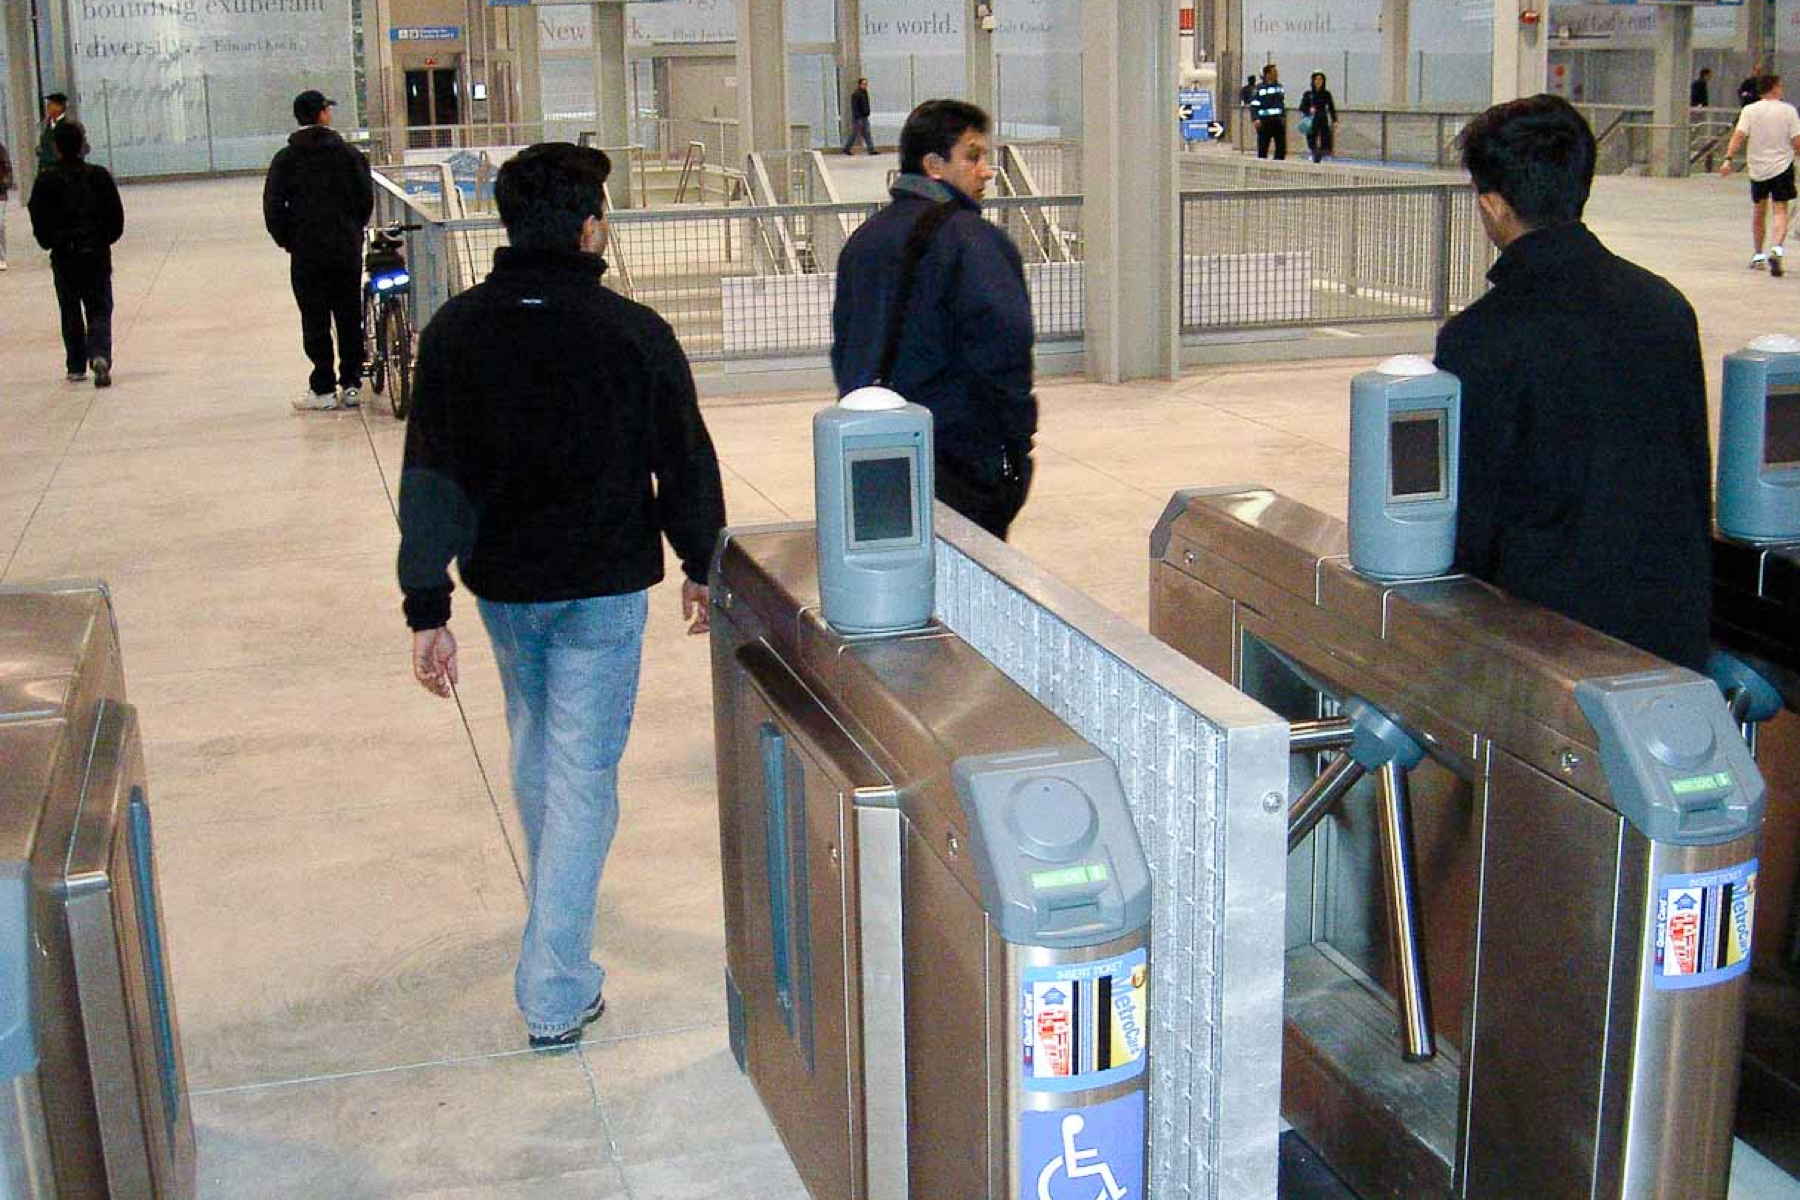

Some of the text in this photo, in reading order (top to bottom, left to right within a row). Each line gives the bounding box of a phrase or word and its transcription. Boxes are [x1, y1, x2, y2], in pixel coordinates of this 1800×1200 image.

[541, 17, 587, 41] New
[863, 13, 889, 35] he
[897, 12, 958, 35] world.
[1253, 12, 1280, 33] the
